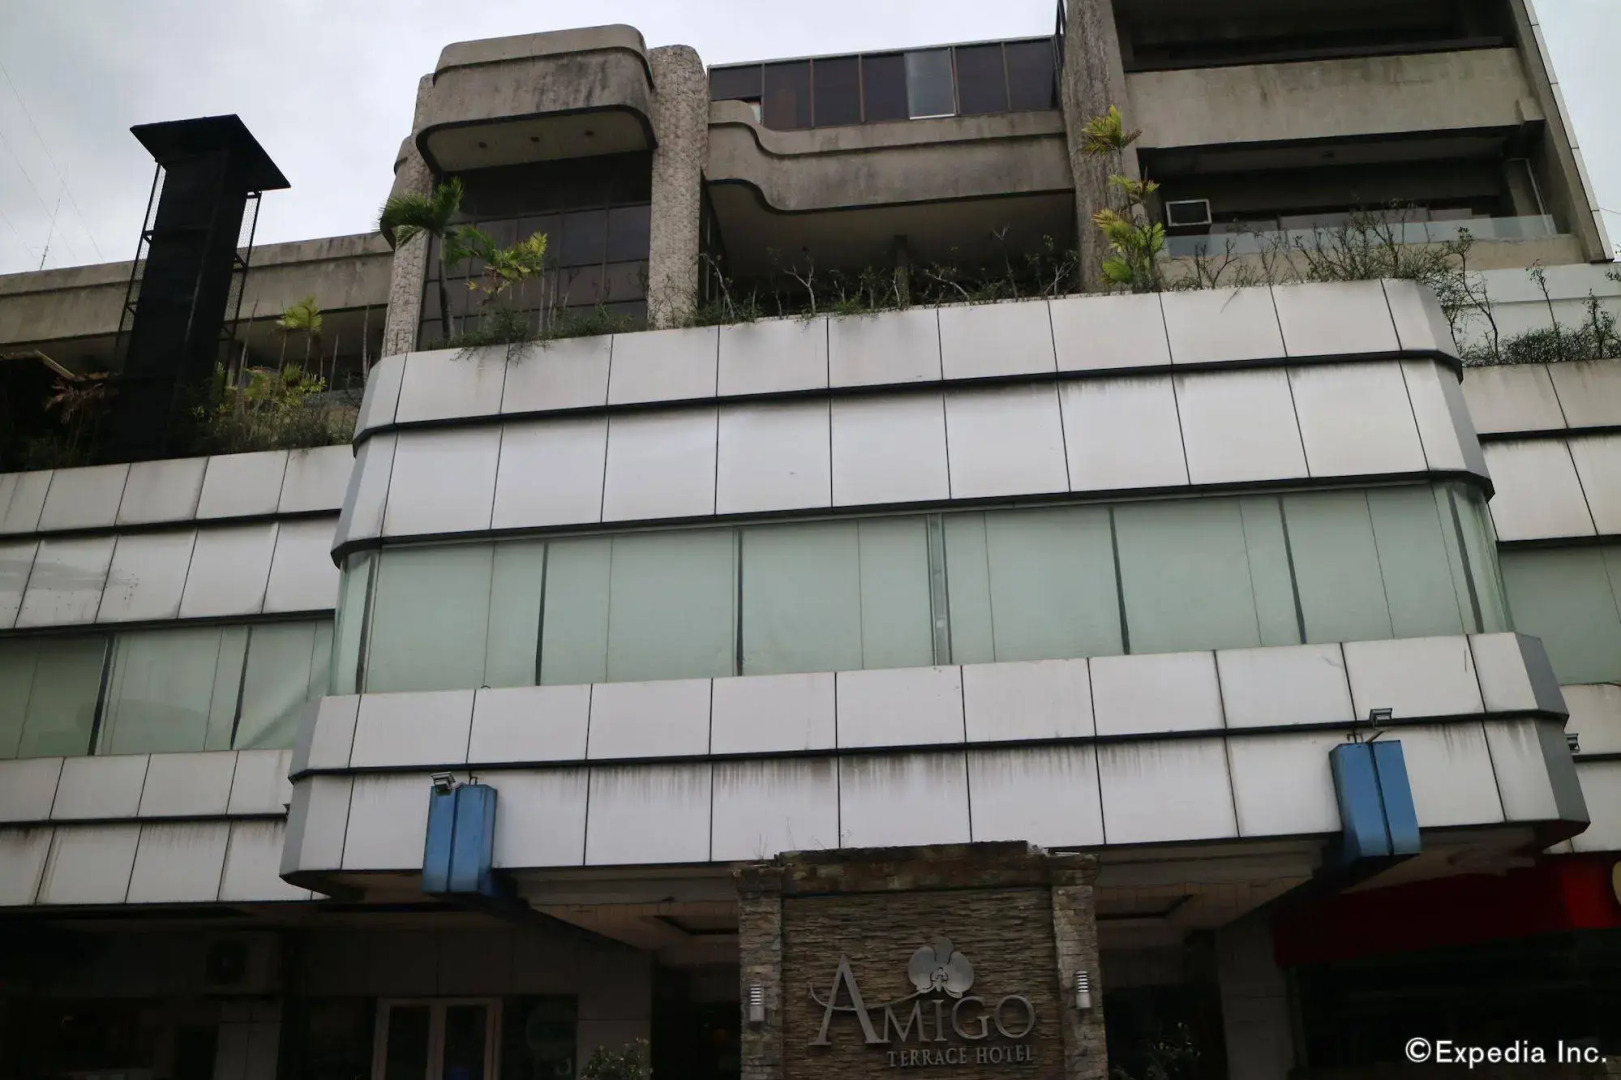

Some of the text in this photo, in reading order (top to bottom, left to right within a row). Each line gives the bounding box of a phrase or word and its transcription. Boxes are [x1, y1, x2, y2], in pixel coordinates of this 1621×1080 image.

[809, 954, 1035, 1045] AMIGO
[888, 1045, 1034, 1067] TERRACE HOTEL
